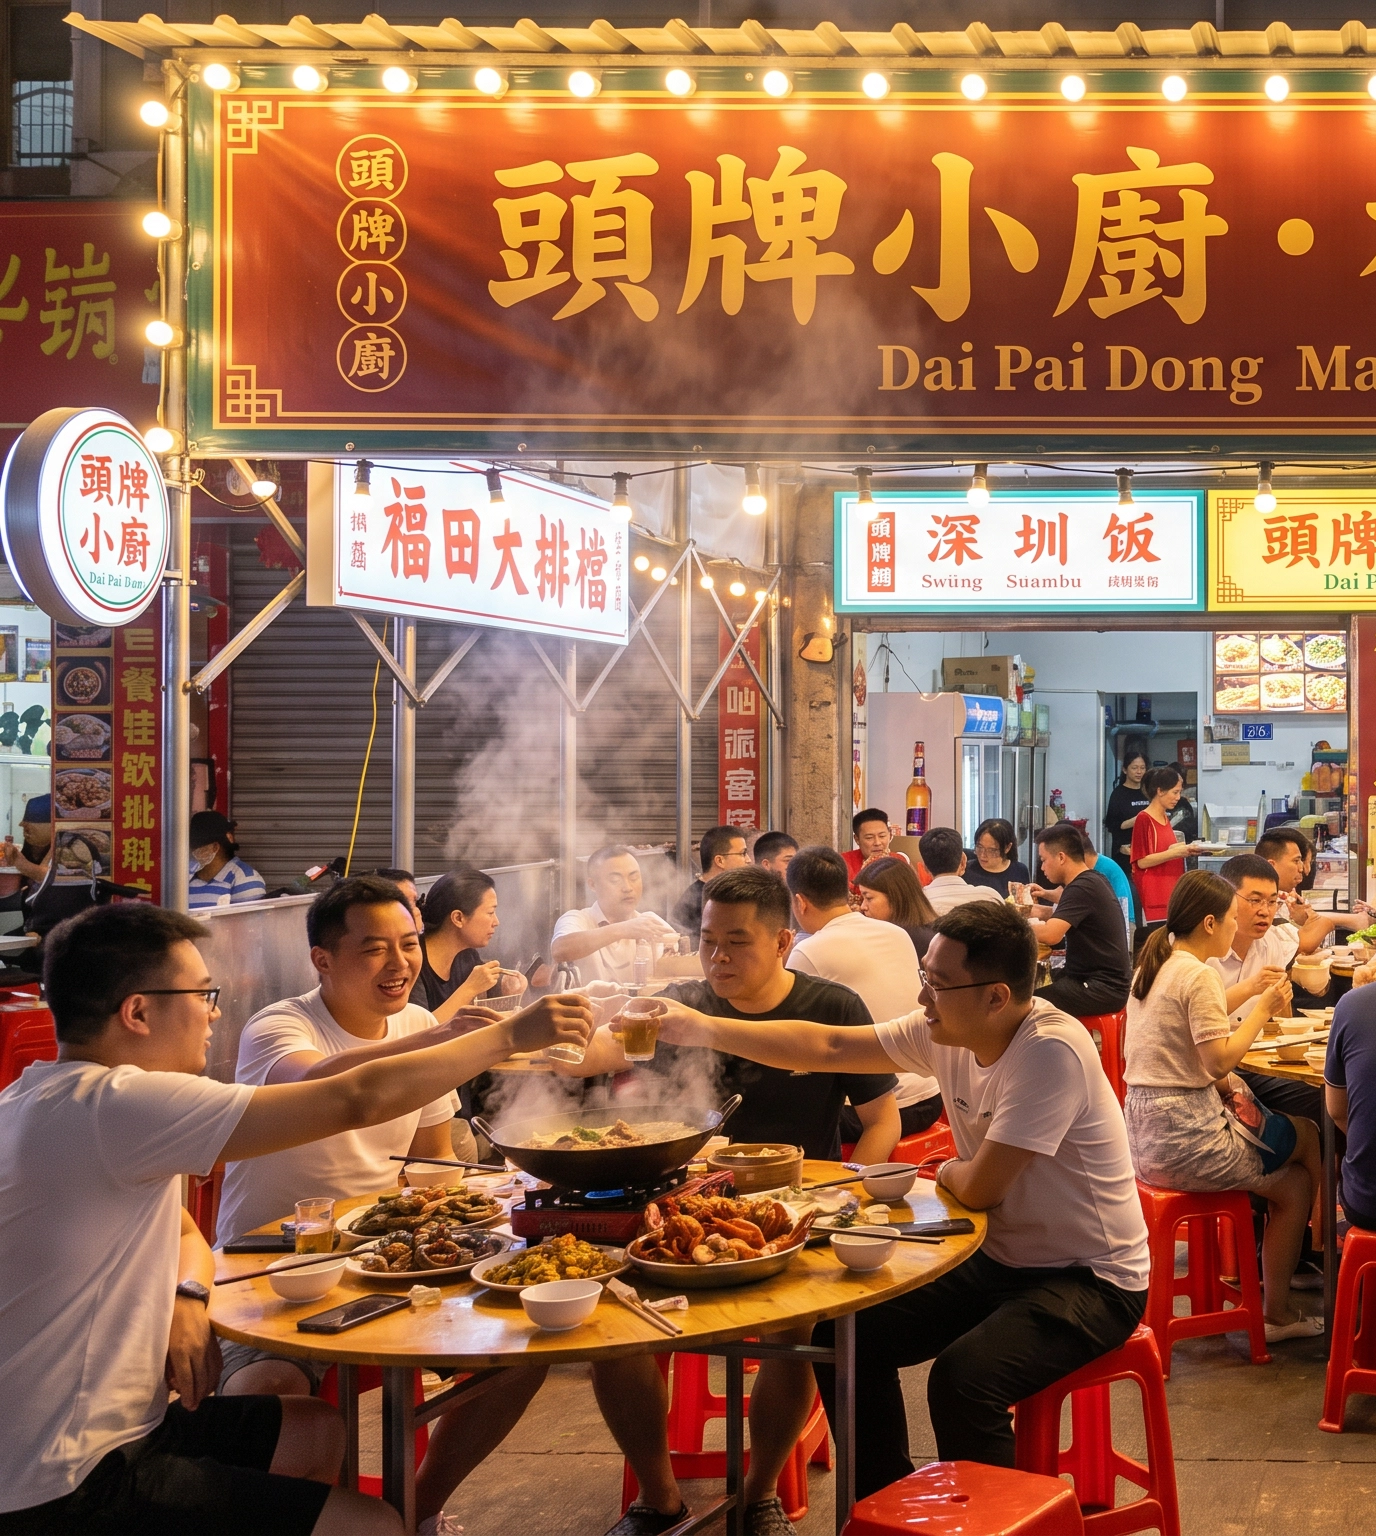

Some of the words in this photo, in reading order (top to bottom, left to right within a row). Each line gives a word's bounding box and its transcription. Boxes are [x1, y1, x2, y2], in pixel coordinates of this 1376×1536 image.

[347, 147, 396, 381] 頭牌小廚
[877, 341, 977, 391] Dai
[994, 341, 1088, 391] Pai
[1105, 344, 1265, 406] Dong
[79, 454, 150, 512] 頭牌
[79, 512, 151, 572] 小廚
[381, 476, 608, 614] 福田大排檔
[89, 571, 105, 585] Dai
[108, 574, 122, 587] Pai
[1323, 573, 1360, 591] Dai
